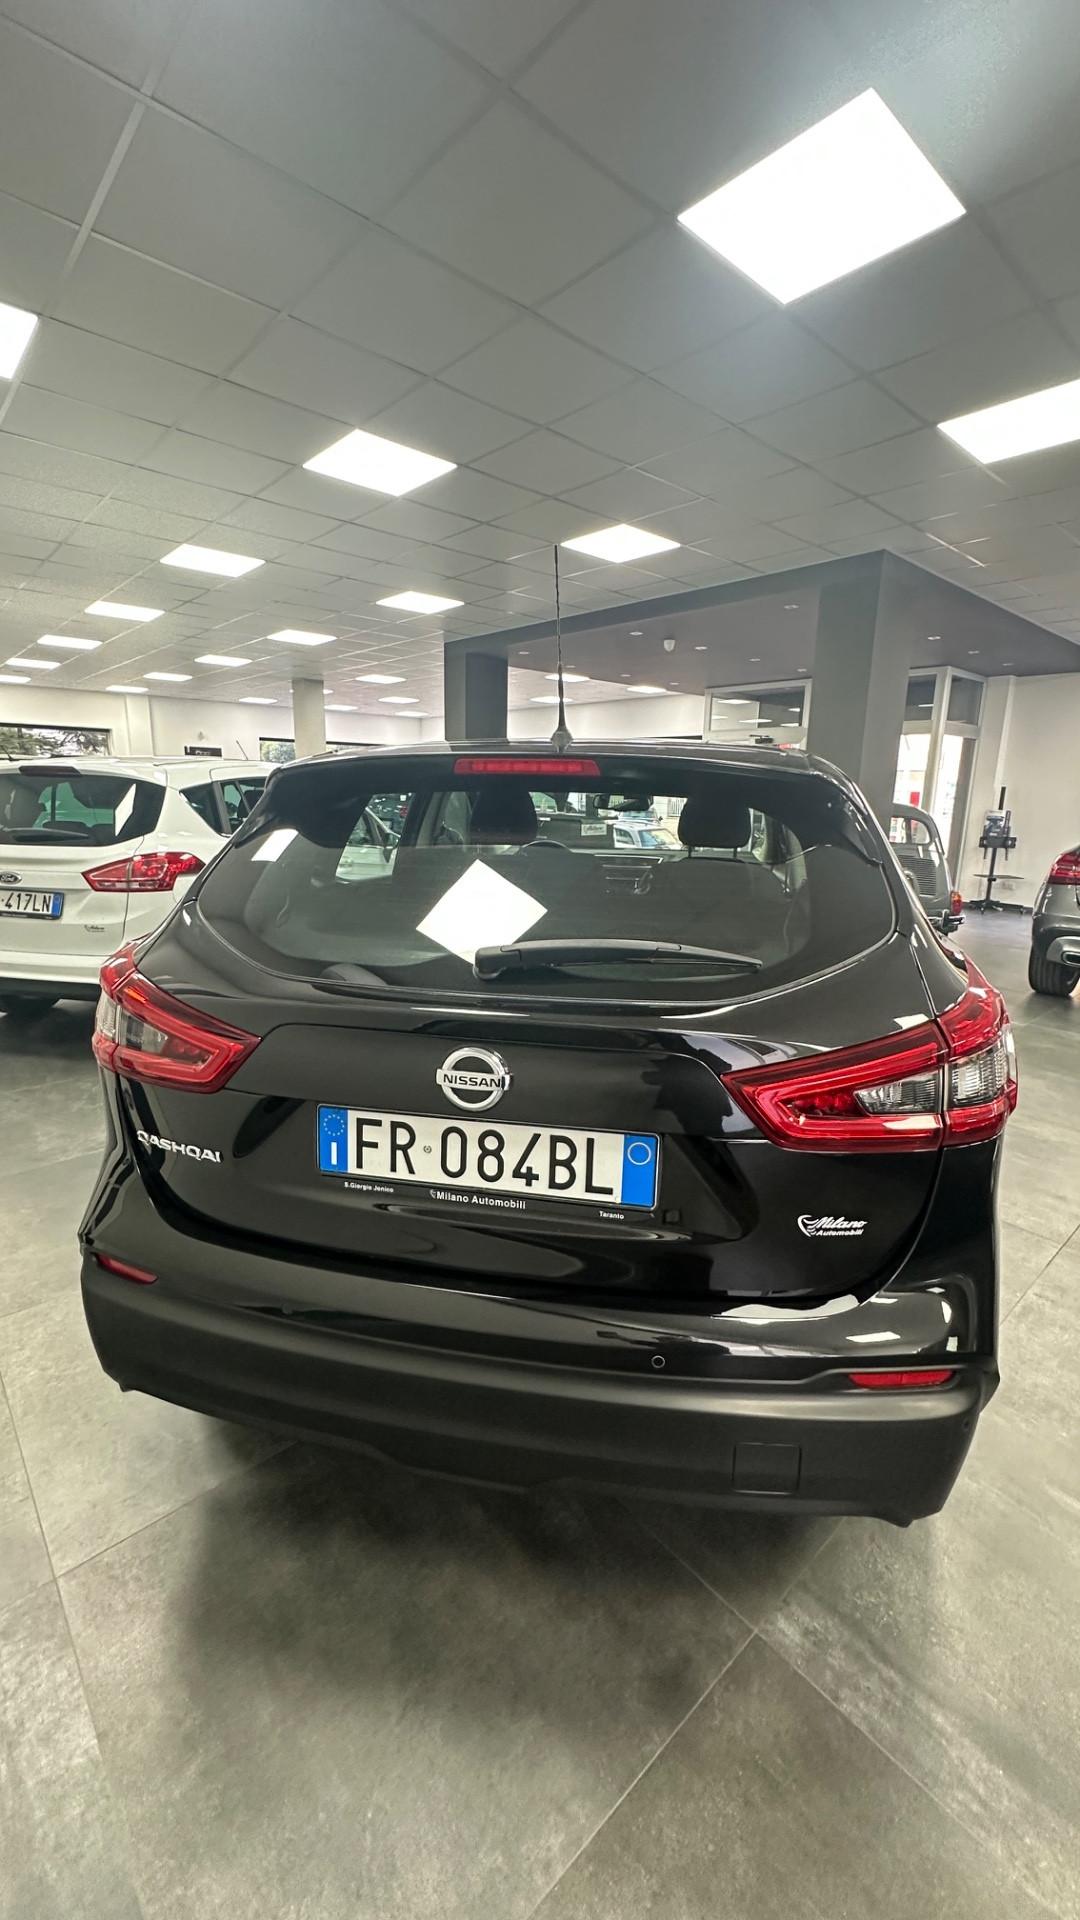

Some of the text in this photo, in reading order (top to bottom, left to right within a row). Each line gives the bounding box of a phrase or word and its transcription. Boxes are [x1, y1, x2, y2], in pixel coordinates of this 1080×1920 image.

[5, 892, 51, 912] 417LN
[443, 1073, 501, 1088] NISSAN
[136, 1130, 222, 1163] QASHQAI
[355, 1116, 416, 1175] FR
[440, 1125, 614, 1196] 084BL
[436, 1190, 526, 1210] Milano Automobili
[599, 1210, 625, 1220] Taranto
[815, 1216, 868, 1229] Milano
